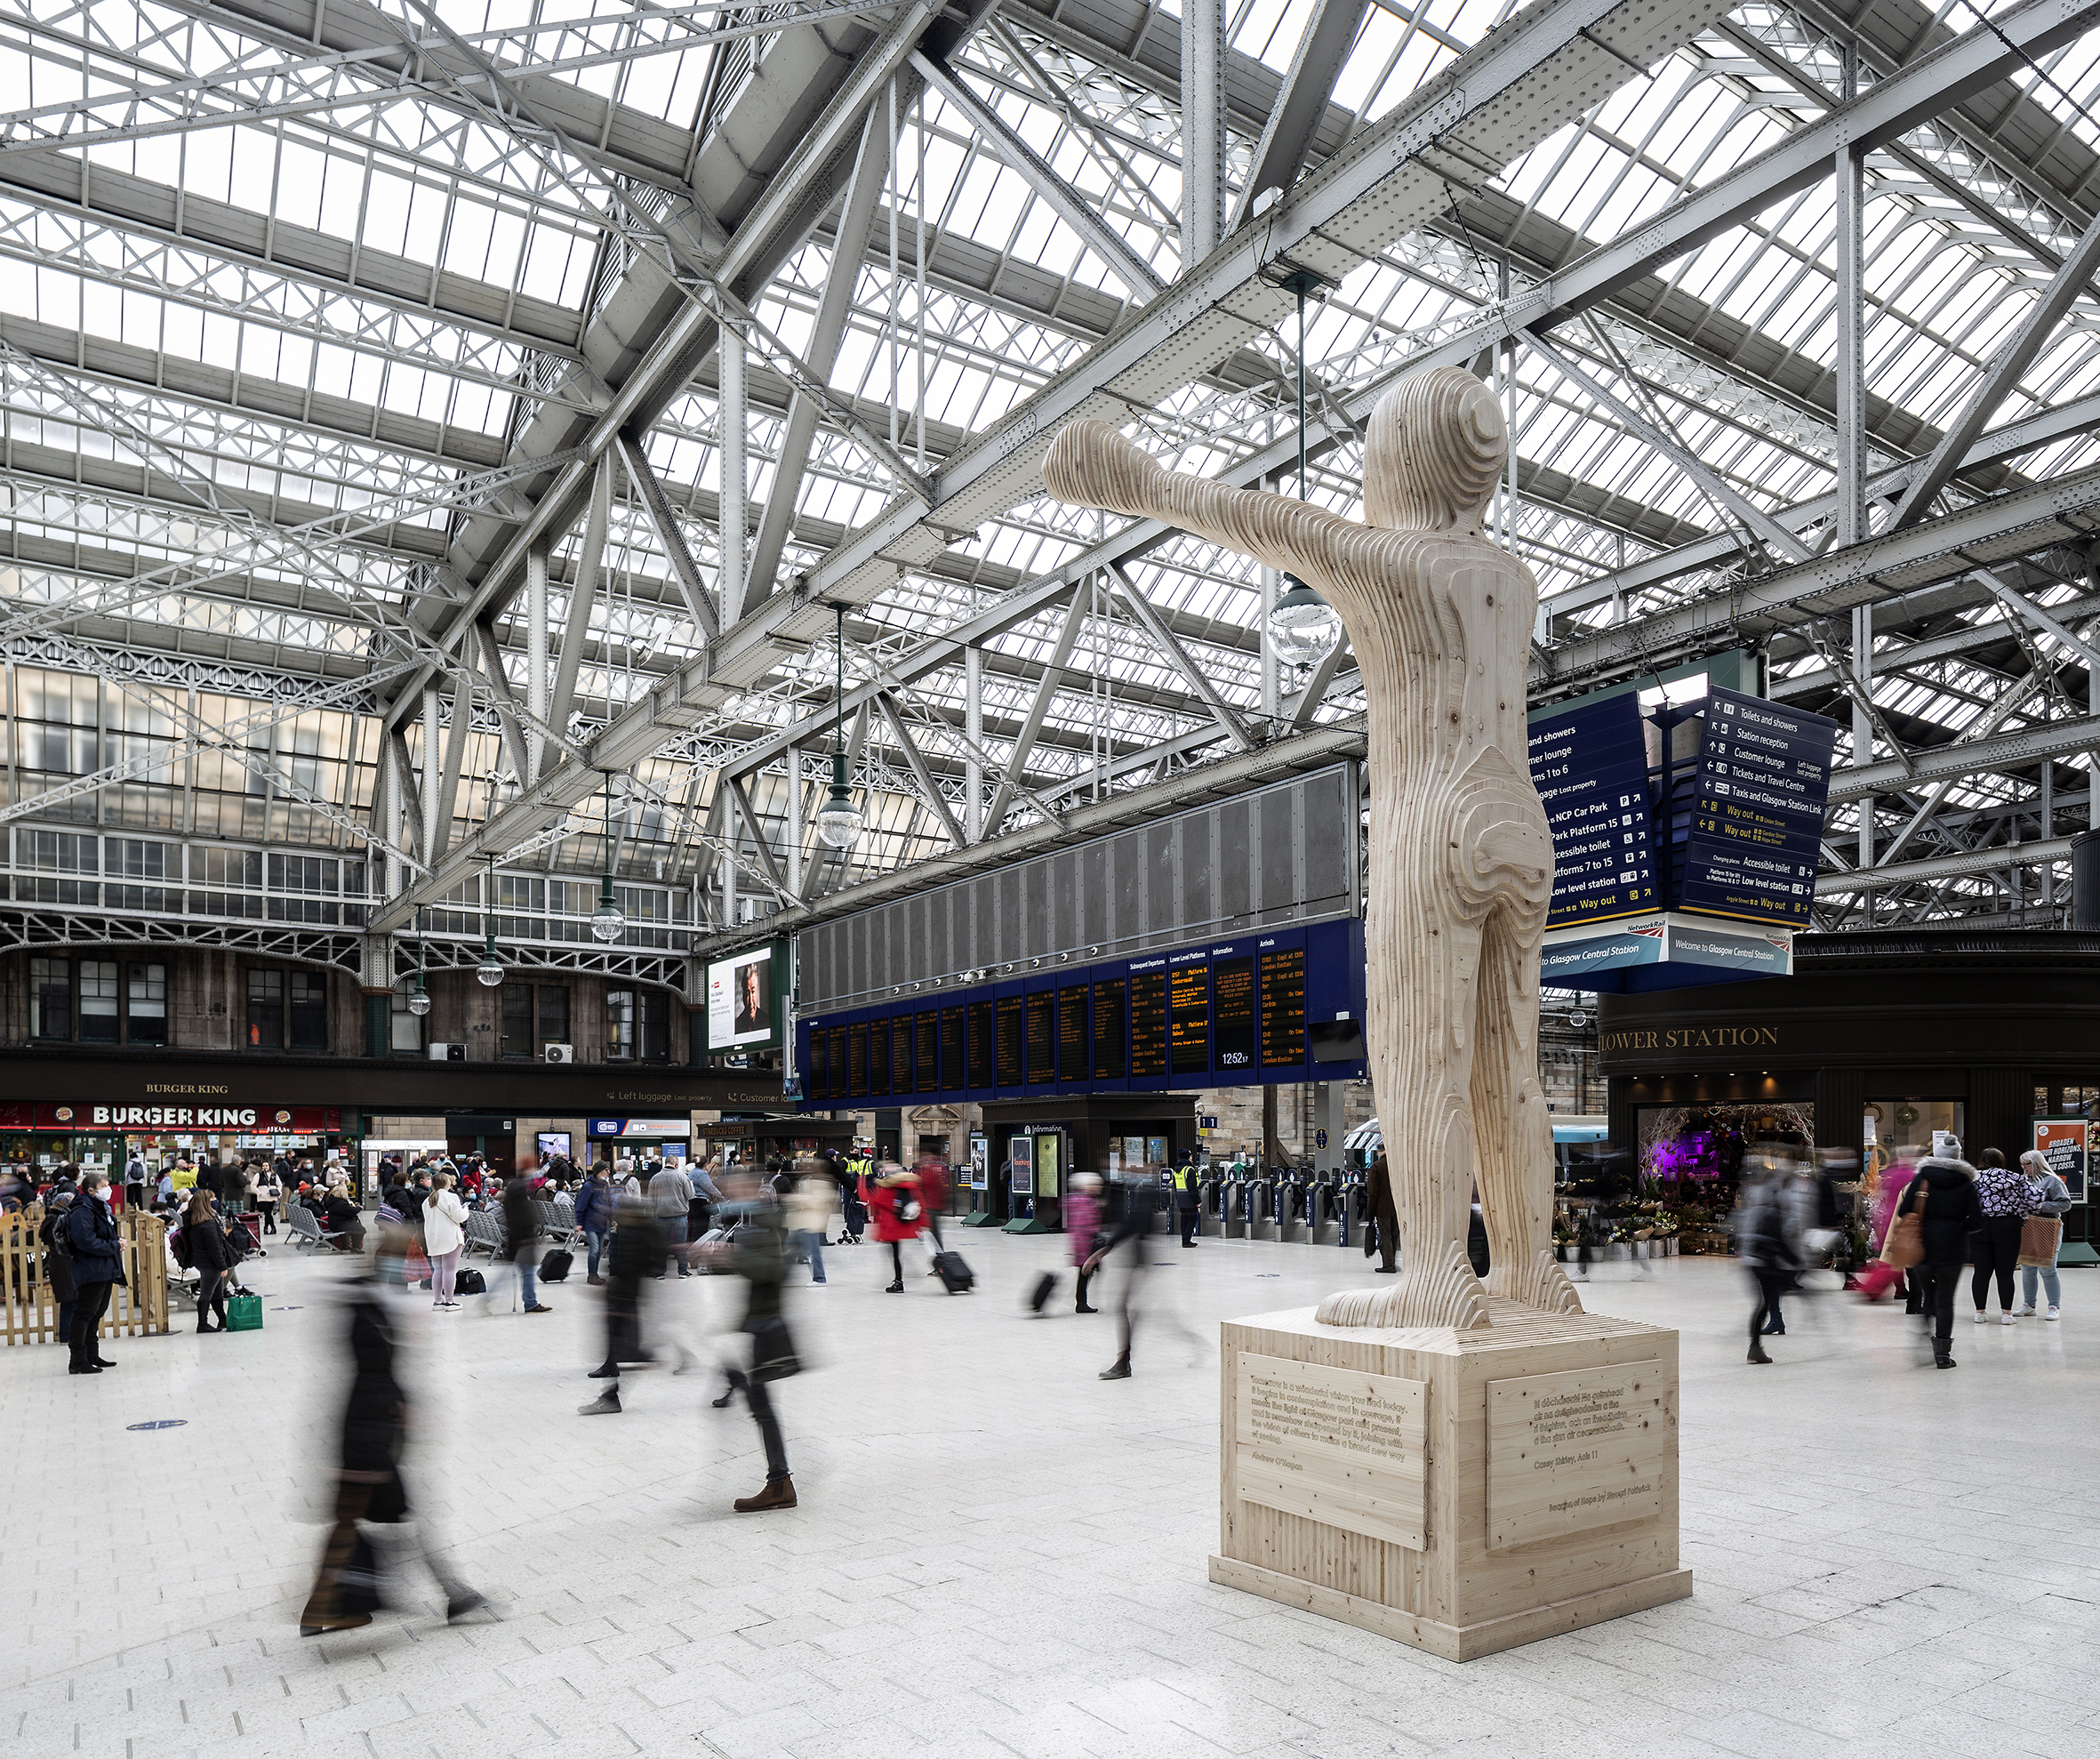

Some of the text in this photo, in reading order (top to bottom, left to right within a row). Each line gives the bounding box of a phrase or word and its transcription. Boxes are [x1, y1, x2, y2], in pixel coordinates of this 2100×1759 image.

[1741, 707, 1798, 733] Toilets and showers
[1528, 726, 1576, 747] and showers
[1737, 728, 1788, 750] Station reception
[1544, 746, 1572, 761] lounge
[1734, 747, 1785, 770] Customer lounge
[1546, 769, 1551, 779] 1
[1552, 767, 1561, 777] to
[1562, 765, 1569, 774] 6
[1806, 764, 1822, 773] luggage
[1732, 766, 1805, 792] Tickets and Travel Centre
[1805, 771, 1822, 782] property
[1539, 779, 1597, 801] gage Lost property
[1732, 786, 1822, 815] Taxis and Glasgow Station Link
[1556, 811, 1572, 822] NCP
[1574, 807, 1588, 818] Car
[1589, 802, 1608, 814] Park
[1727, 805, 1741, 818] Way
[1742, 810, 1754, 820] out
[1551, 818, 1618, 841] Park Platform 15
[1725, 824, 1739, 837] Way
[1739, 829, 1751, 838] out
[1588, 839, 1611, 851] toilet
[1585, 861, 1591, 871] 7
[1592, 861, 1601, 869] to
[1603, 857, 1613, 867] 15
[1713, 855, 1729, 864] Changing
[1743, 857, 1774, 871] Accessible
[1775, 863, 1791, 874] toilet
[1551, 877, 1616, 896] Low level station
[1742, 875, 1789, 892] Low level station
[1580, 899, 1598, 910] Way
[1601, 895, 1616, 905] out
[1726, 895, 1738, 904] Argyle
[1760, 897, 1774, 911] Way
[1775, 901, 1786, 910] out
[1259, 939, 1275, 948] Arrivals
[1675, 939, 1774, 961] Welcome to Glasgow Central Station
[1212, 947, 1233, 956] Information
[1549, 954, 1581, 967] Glasgow
[1581, 948, 1609, 960] Central
[1610, 944, 1639, 956] Station
[1129, 959, 1165, 970] Subsequent Departures
[1666, 1027, 1779, 1048] STATION
[146, 1084, 228, 1094] BURGER KING
[619, 1092, 637, 1100] Left
[638, 1092, 671, 1103] luggage
[689, 1095, 712, 1103] property
[740, 1093, 779, 1102] Customer
[93, 1106, 194, 1125] BURGER
[197, 1108, 256, 1126] KING
[703, 1126, 745, 1136] STARBUCKS COFFEE
[2048, 1137, 2075, 1148] BROADEN
[2053, 1144, 2082, 1155] HORIZONS,
[1014, 1158, 1031, 1169] Touching
[2048, 1153, 2073, 1163] NARROW
[2057, 1161, 2076, 1170] COSTS.
[1329, 1390, 1350, 1402] vision
[1351, 1395, 1365, 1405] you
[1366, 1397, 1382, 1408] had
[1382, 1400, 1408, 1414] today.
[1533, 1459, 1554, 1470] Casey
[1573, 1498, 1580, 1507] of
[1581, 1496, 1597, 1506] Hope
[1598, 1493, 1606, 1503] by
